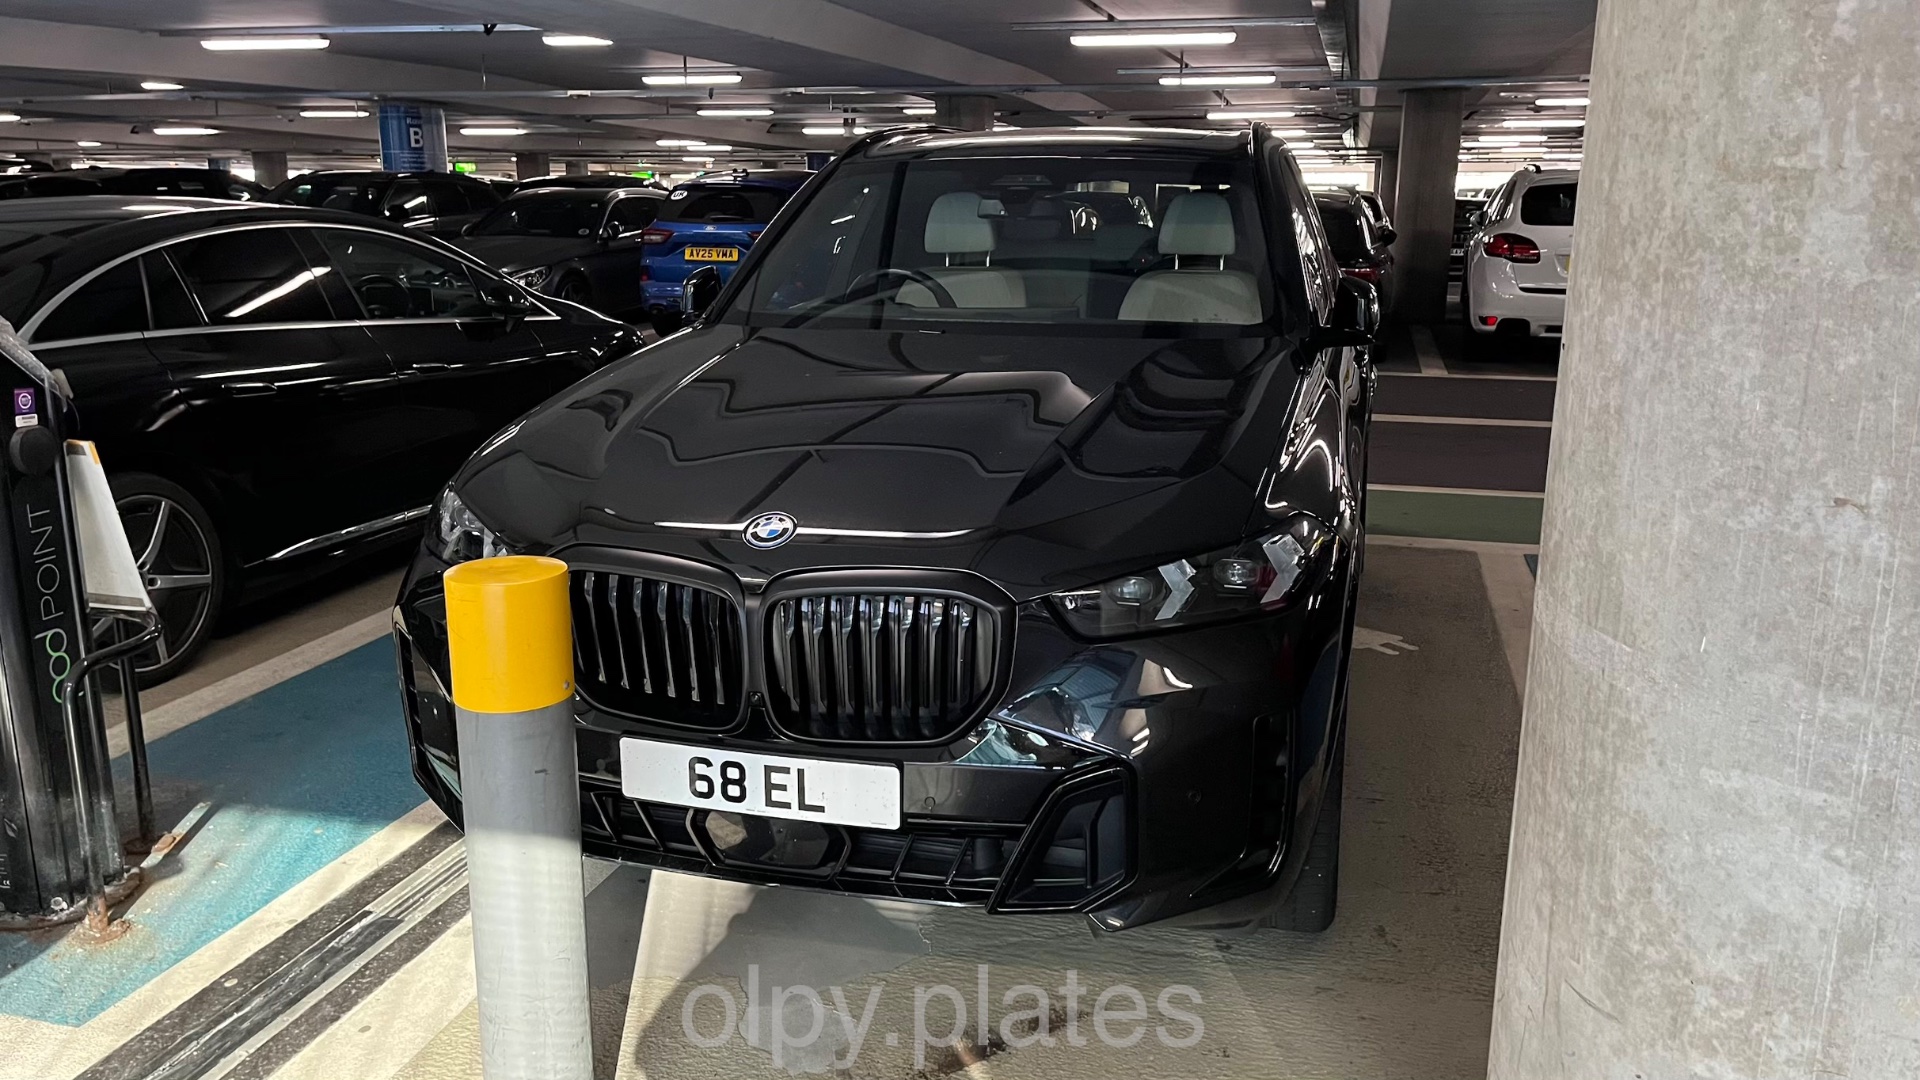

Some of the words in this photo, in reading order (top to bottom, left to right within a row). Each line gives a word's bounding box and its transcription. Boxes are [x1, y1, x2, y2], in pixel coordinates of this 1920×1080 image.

[409, 127, 424, 148] B
[688, 248, 713, 258] AV25
[716, 248, 734, 259] VMA
[26, 503, 65, 621] POINT
[688, 756, 747, 804] 68
[763, 764, 826, 813] EL
